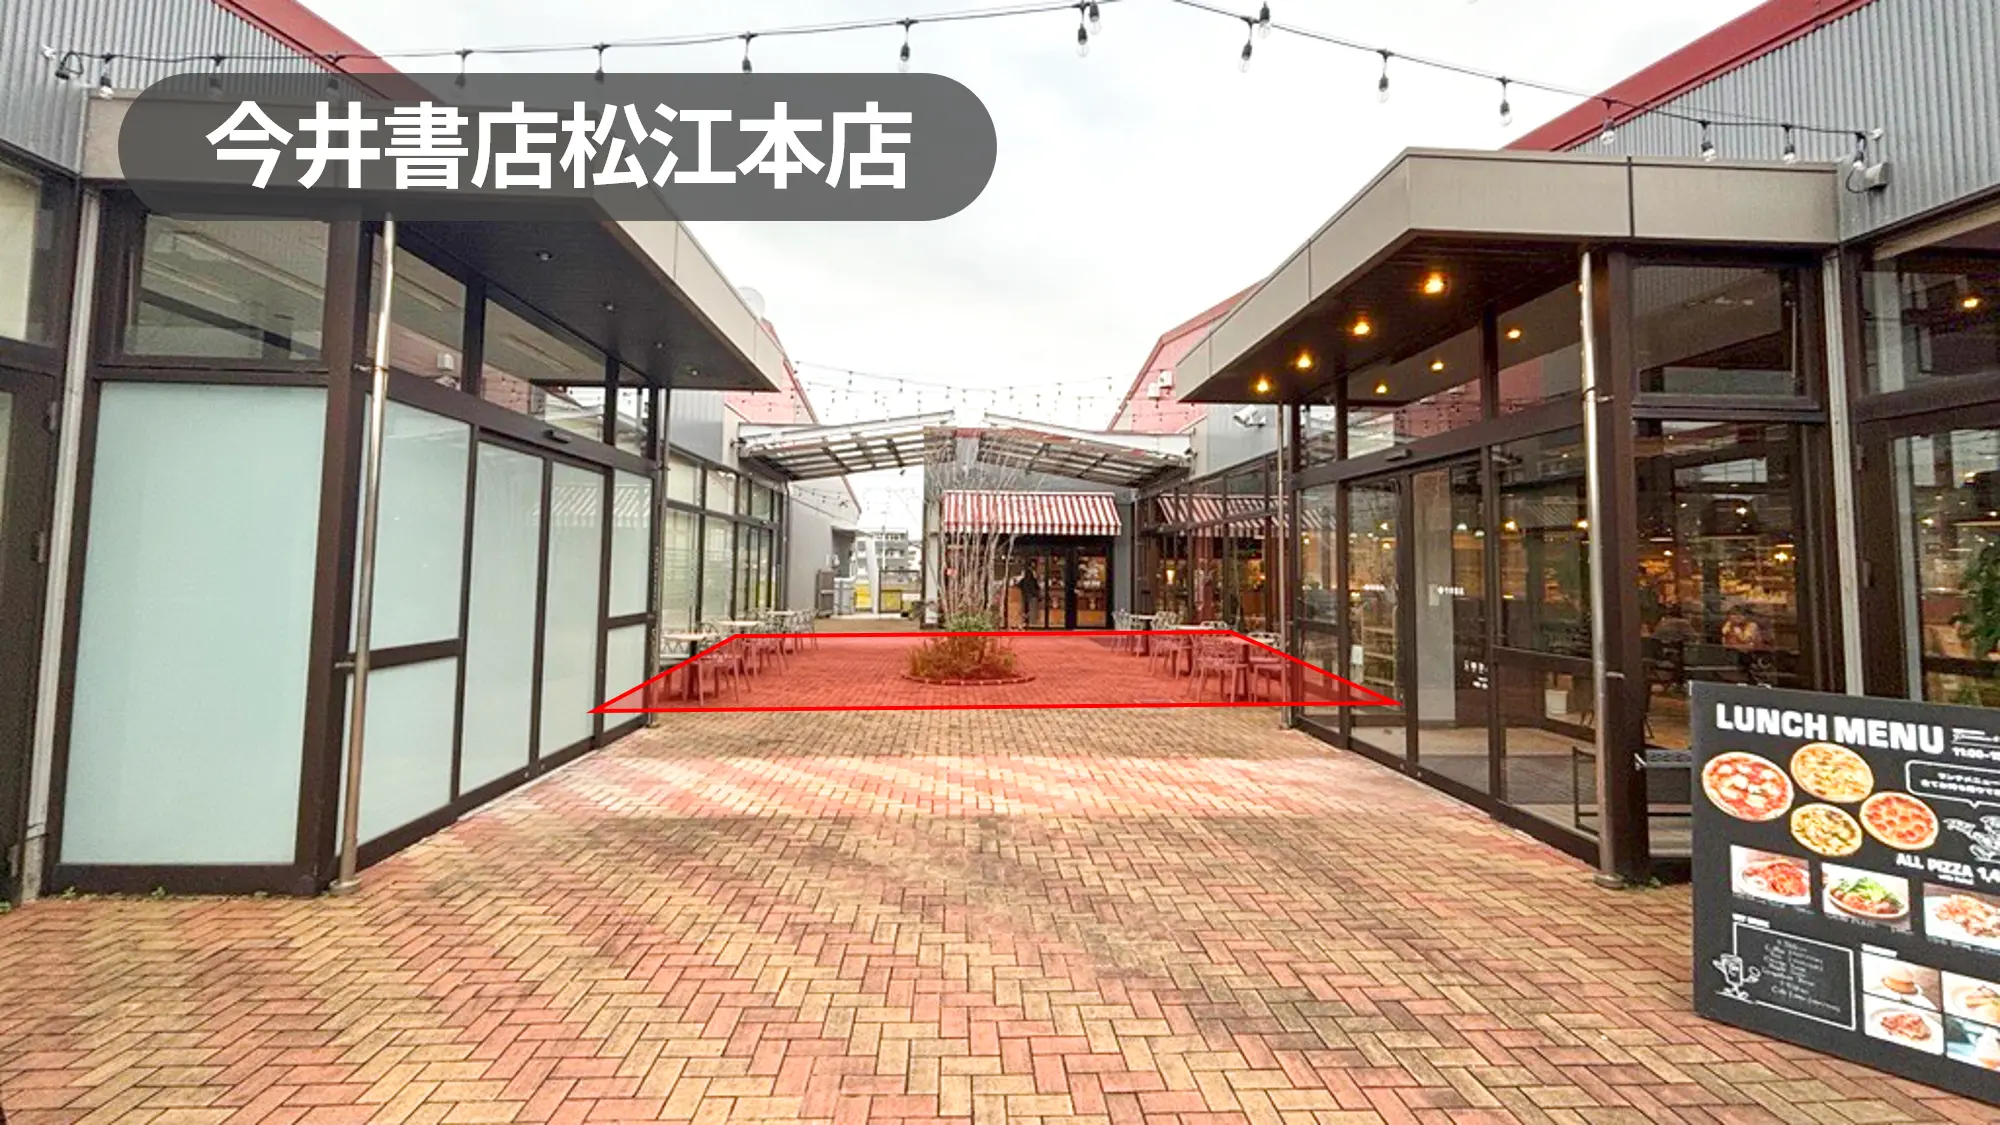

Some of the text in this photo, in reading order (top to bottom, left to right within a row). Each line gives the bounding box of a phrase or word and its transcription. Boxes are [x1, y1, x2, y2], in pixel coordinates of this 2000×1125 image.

[1716, 703, 1945, 754] LUNCH MENU
[1896, 853, 1925, 870] ALL
[1927, 858, 1974, 878] PIZZA
